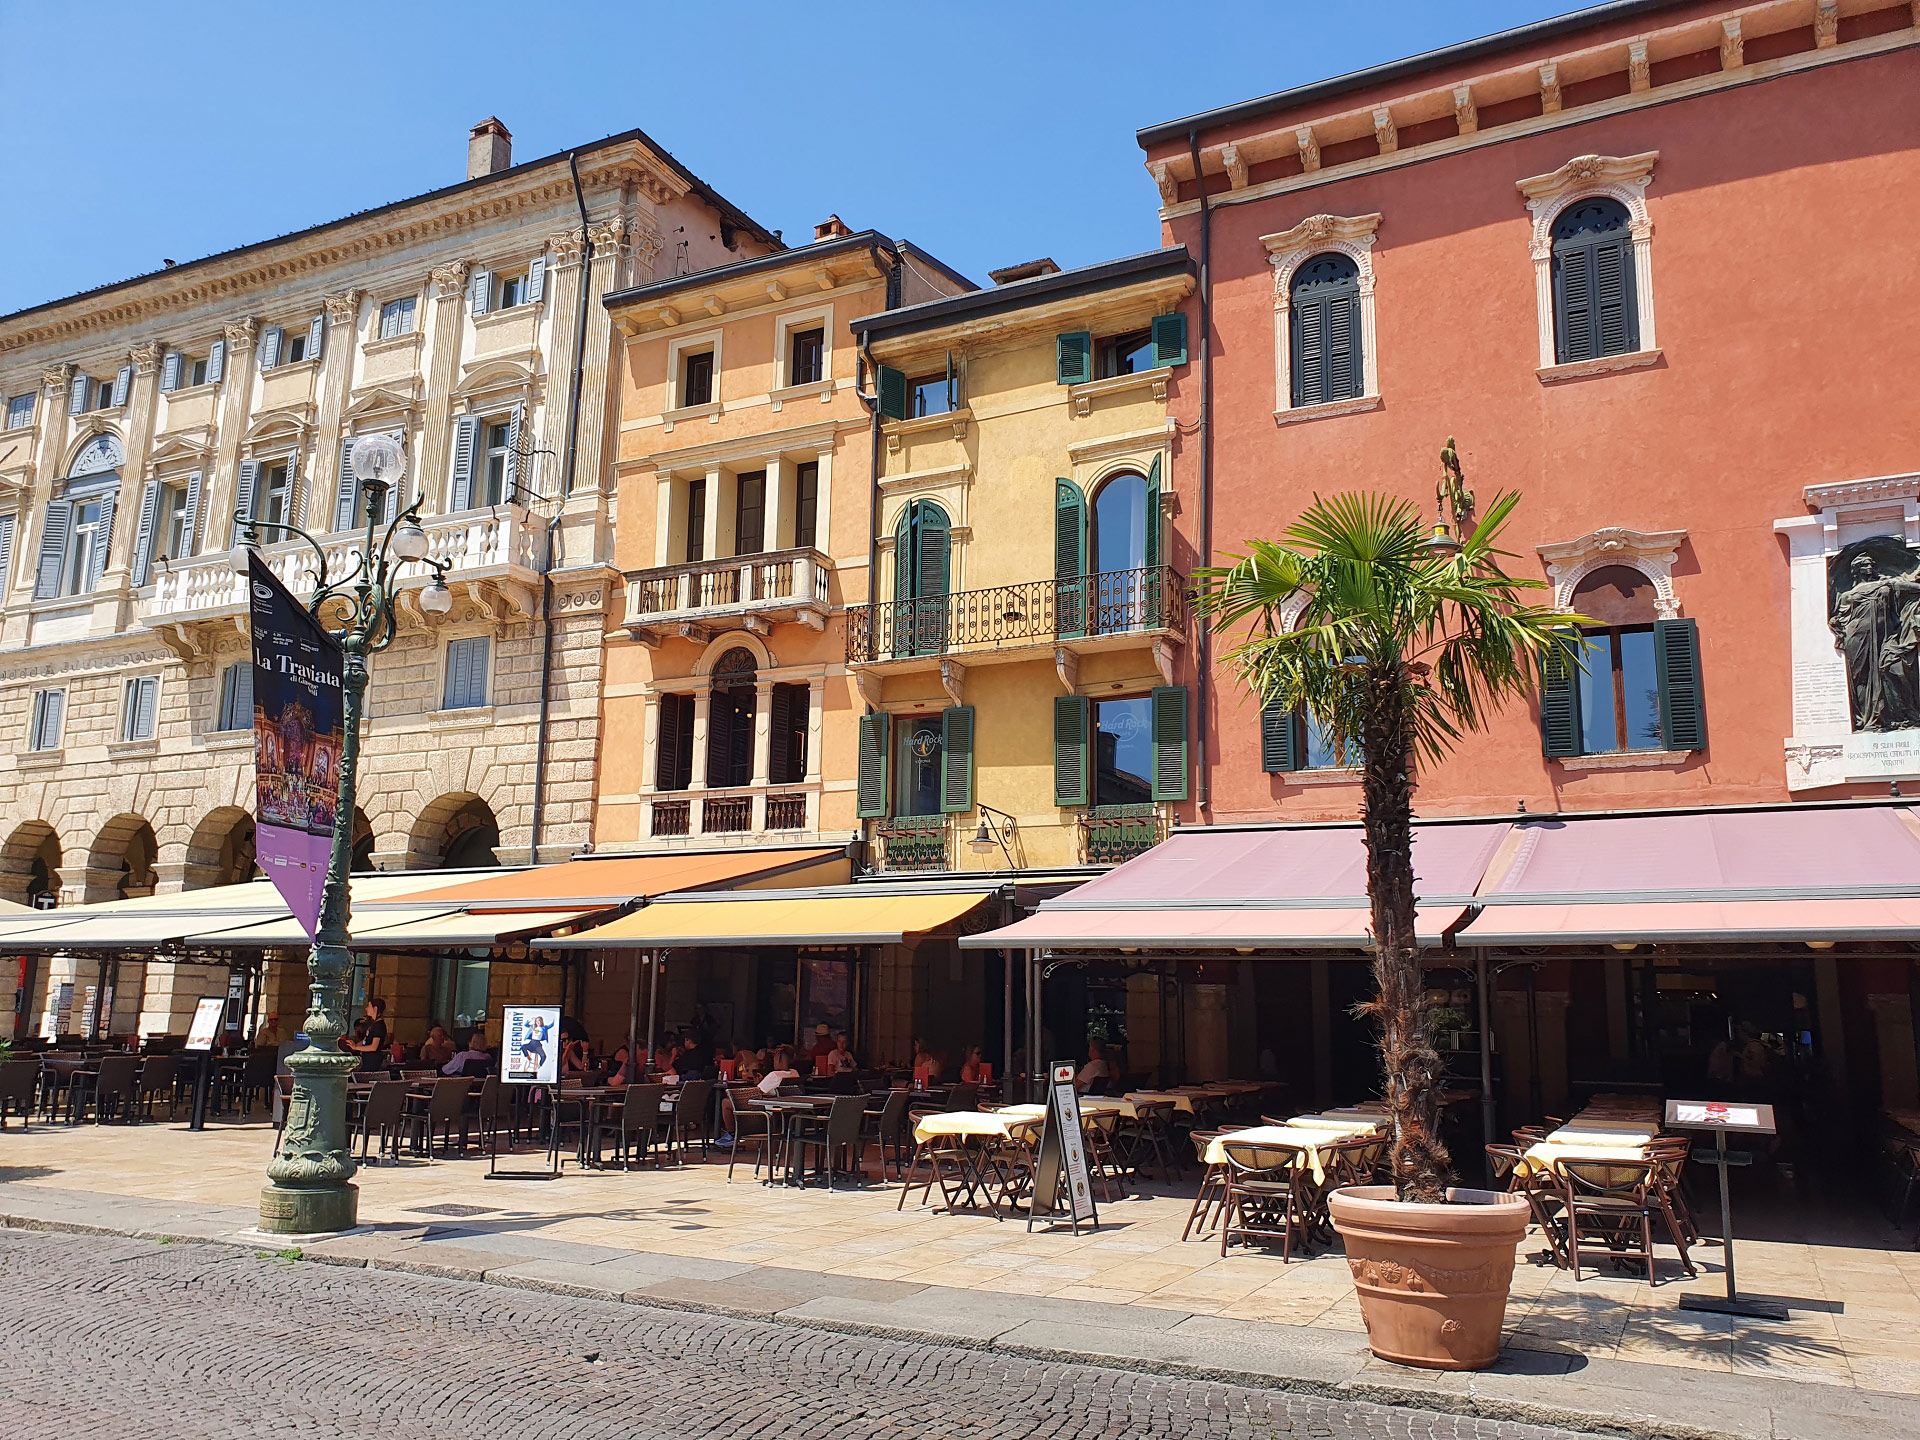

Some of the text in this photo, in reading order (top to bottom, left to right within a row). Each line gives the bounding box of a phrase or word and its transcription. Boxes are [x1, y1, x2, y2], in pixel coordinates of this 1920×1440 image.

[256, 647, 340, 688] La Traviata
[1102, 718, 1148, 730] Hard Rock
[903, 734, 943, 746] Hard Rock
[38, 897, 55, 910] T
[511, 1011, 524, 1056] LEGENDARY
